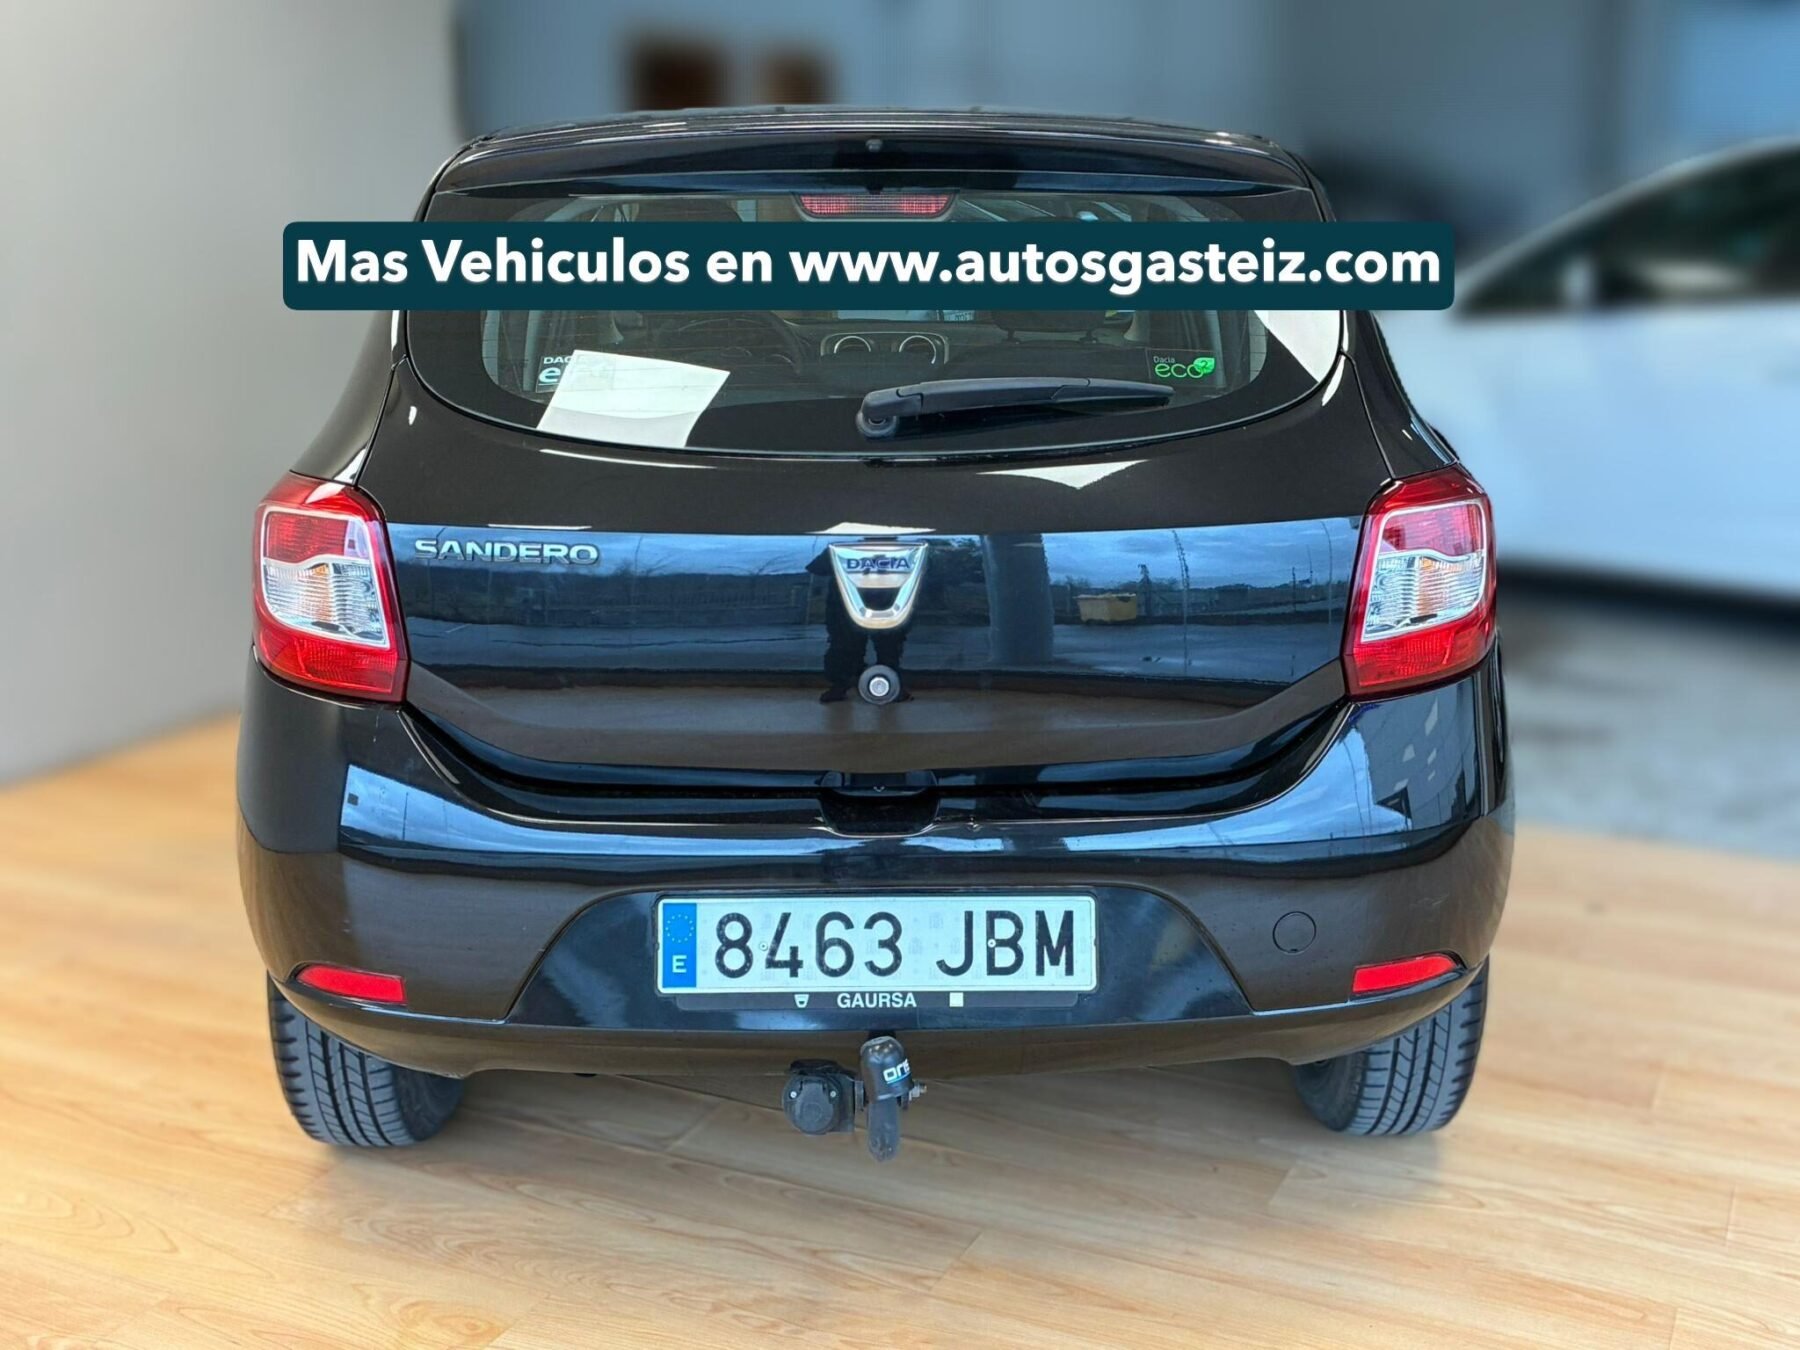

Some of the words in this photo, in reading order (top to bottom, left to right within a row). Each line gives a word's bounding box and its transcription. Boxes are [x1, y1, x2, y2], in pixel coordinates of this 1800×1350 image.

[414, 539, 599, 565] SANDERO
[846, 557, 911, 570] DACIA
[714, 911, 904, 979] 8463
[935, 909, 1075, 977] JBM
[671, 954, 688, 974] E
[836, 992, 918, 1009] GAURSA
